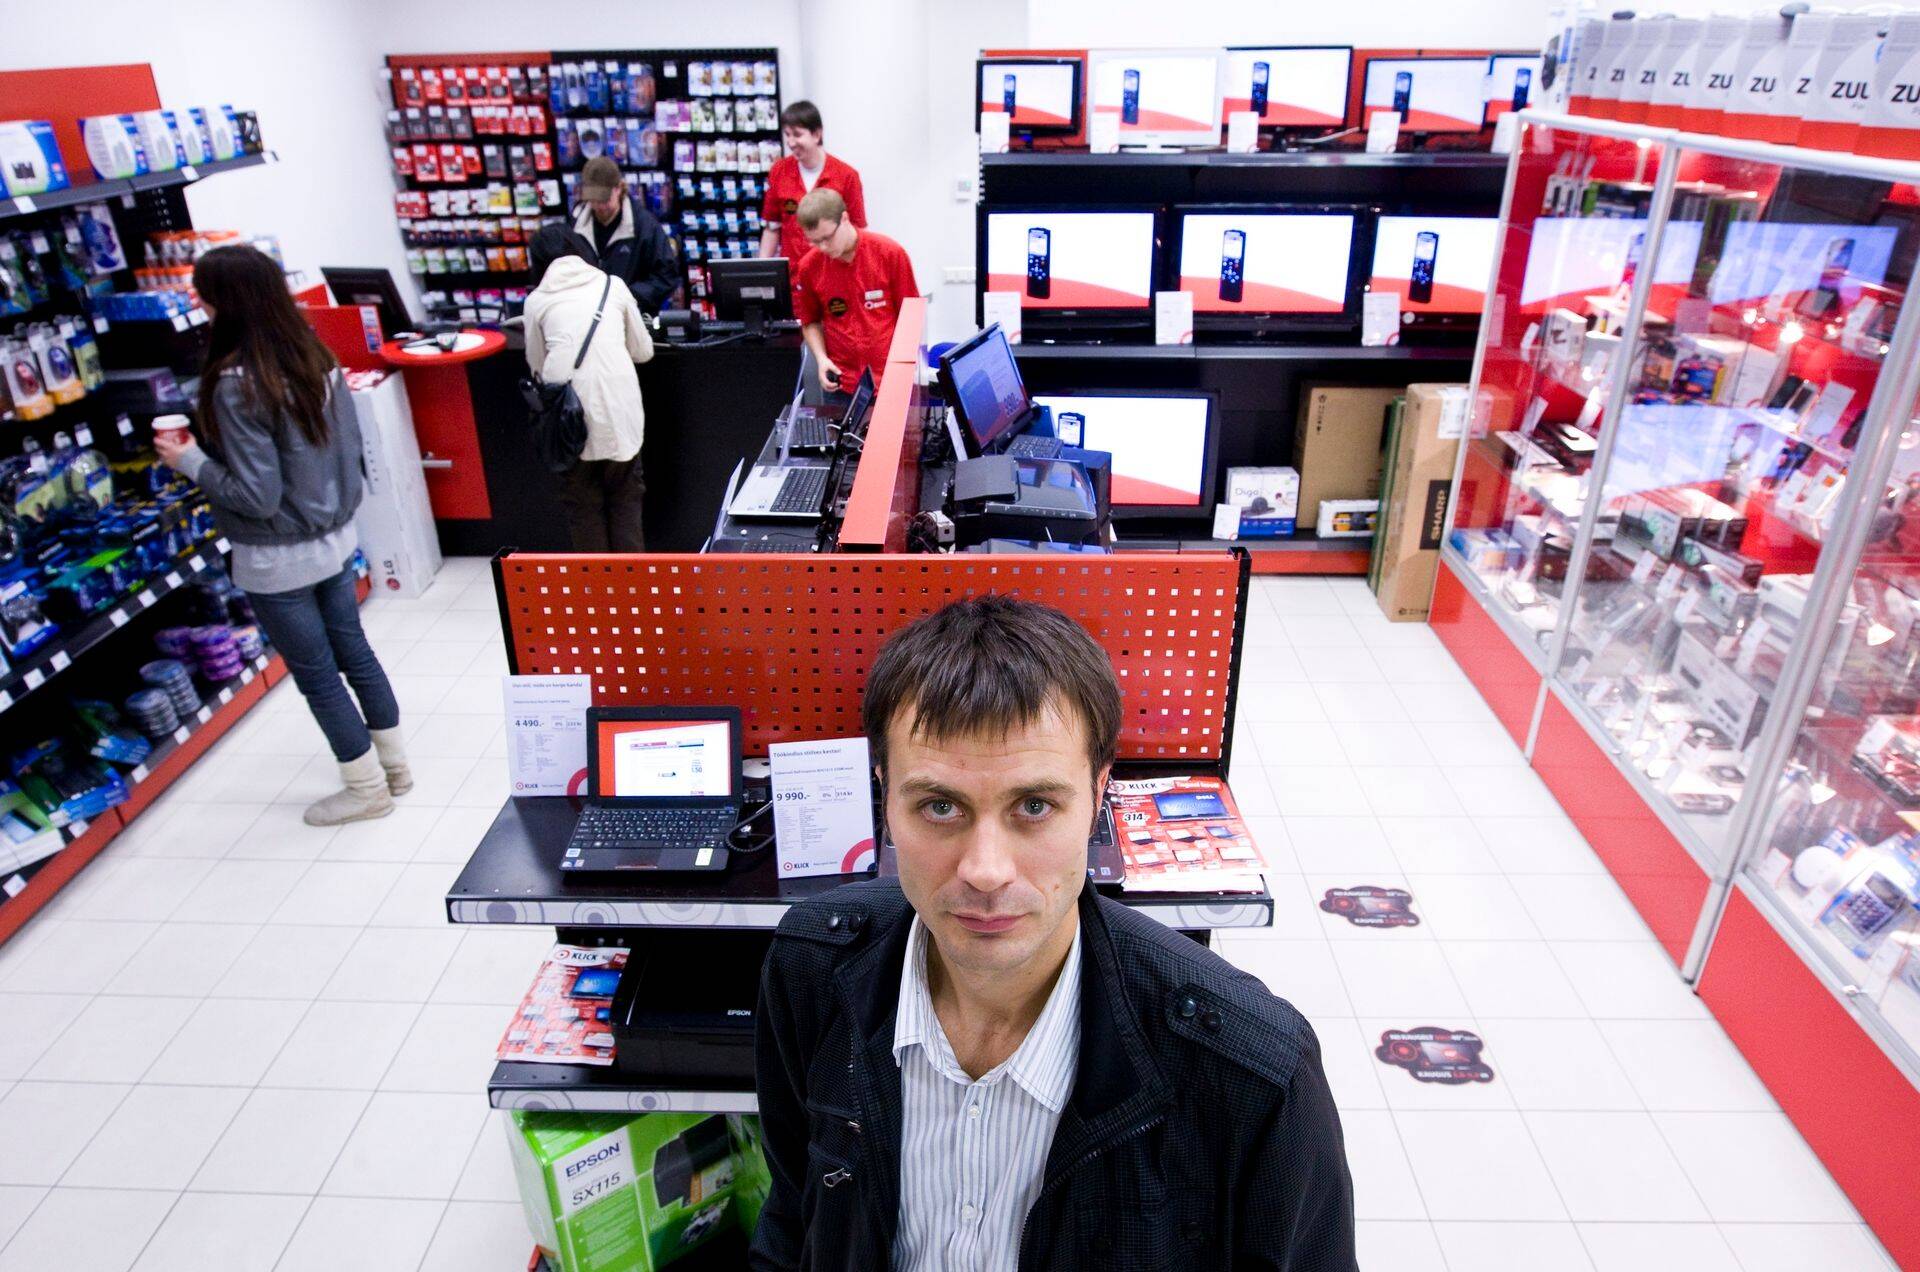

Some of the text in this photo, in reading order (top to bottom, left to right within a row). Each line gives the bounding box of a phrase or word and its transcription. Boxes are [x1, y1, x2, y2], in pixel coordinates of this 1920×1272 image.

[1708, 73, 1733, 89] ZU
[1749, 76, 1776, 93] ZU
[1796, 78, 1811, 94] Z
[1430, 489, 1447, 541] SHARP
[571, 952, 598, 961] KLICK
[565, 1142, 620, 1177] EPSON
[572, 1170, 621, 1206] SX115
